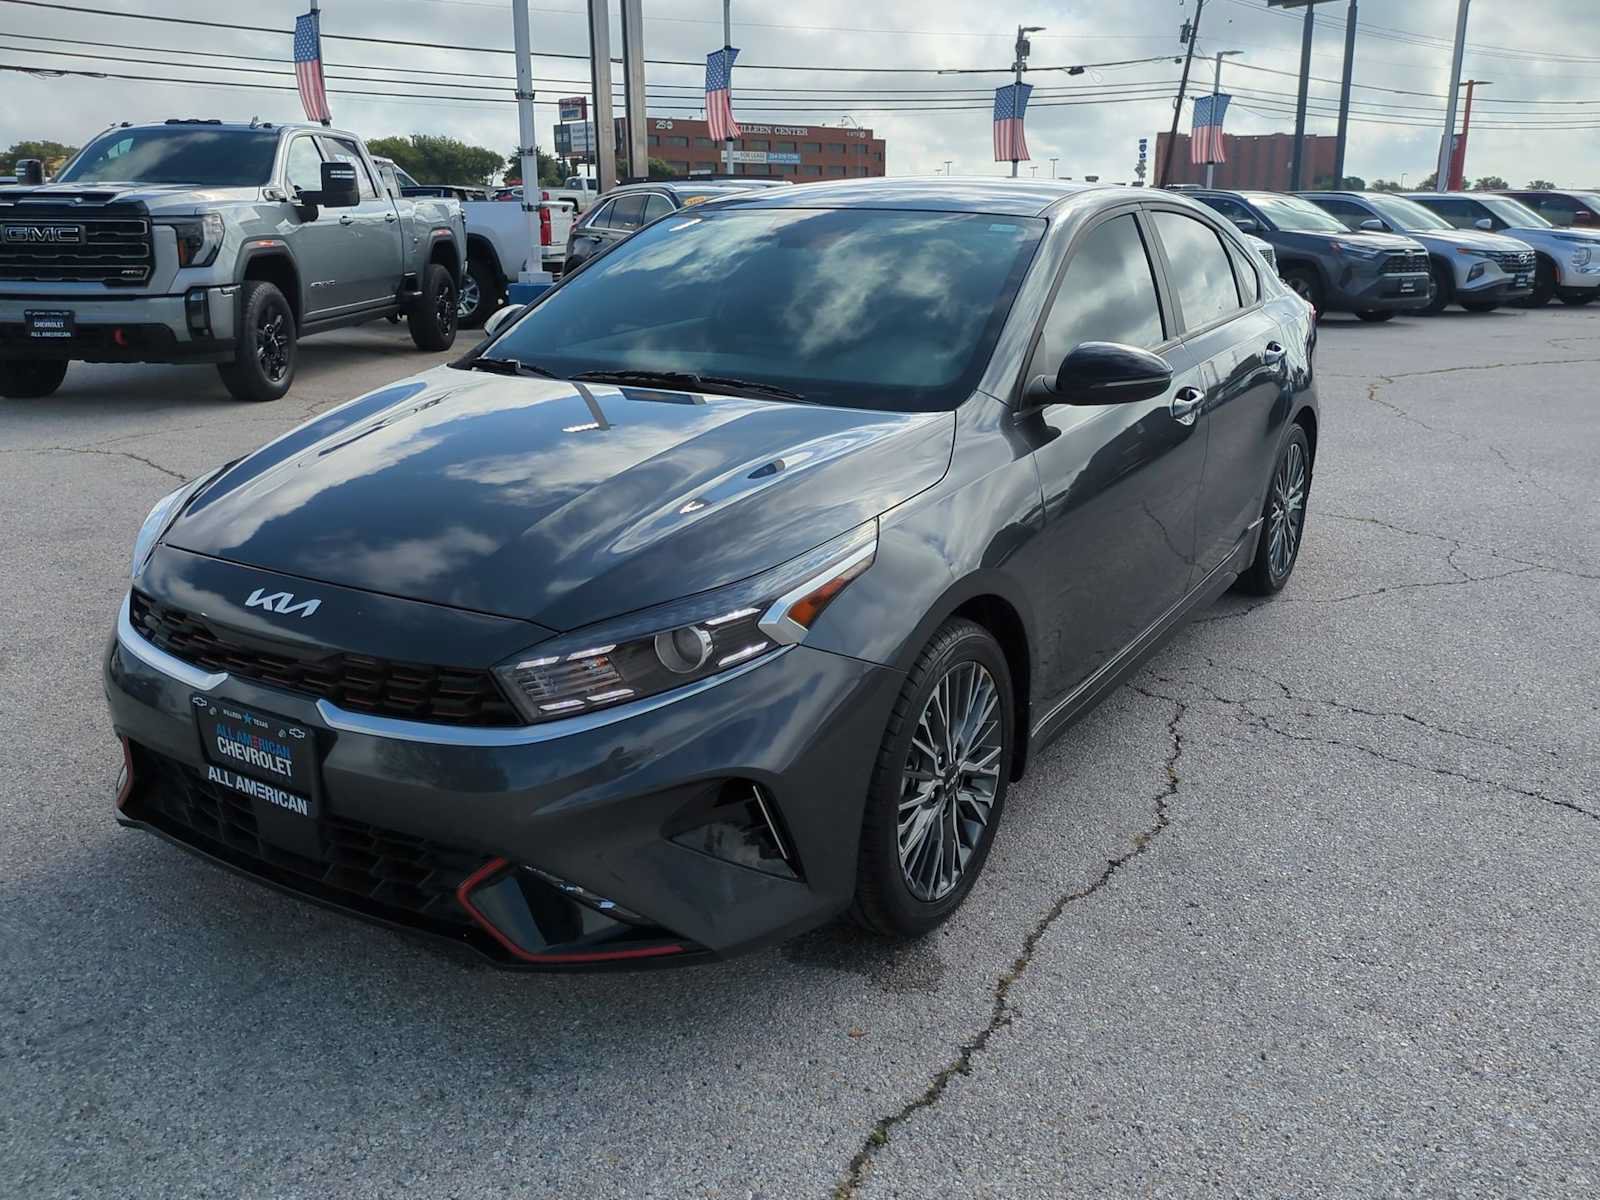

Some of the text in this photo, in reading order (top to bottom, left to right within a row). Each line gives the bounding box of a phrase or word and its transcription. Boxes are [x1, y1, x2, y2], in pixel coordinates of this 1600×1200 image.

[739, 125, 809, 136] ILLEEN CENTER
[5, 227, 79, 242] GMC
[245, 587, 322, 618] KIA
[216, 722, 291, 759] ALL AMERICAN
[217, 736, 292, 777] CHEVROLET
[208, 766, 308, 817] ALL AMERICAN
